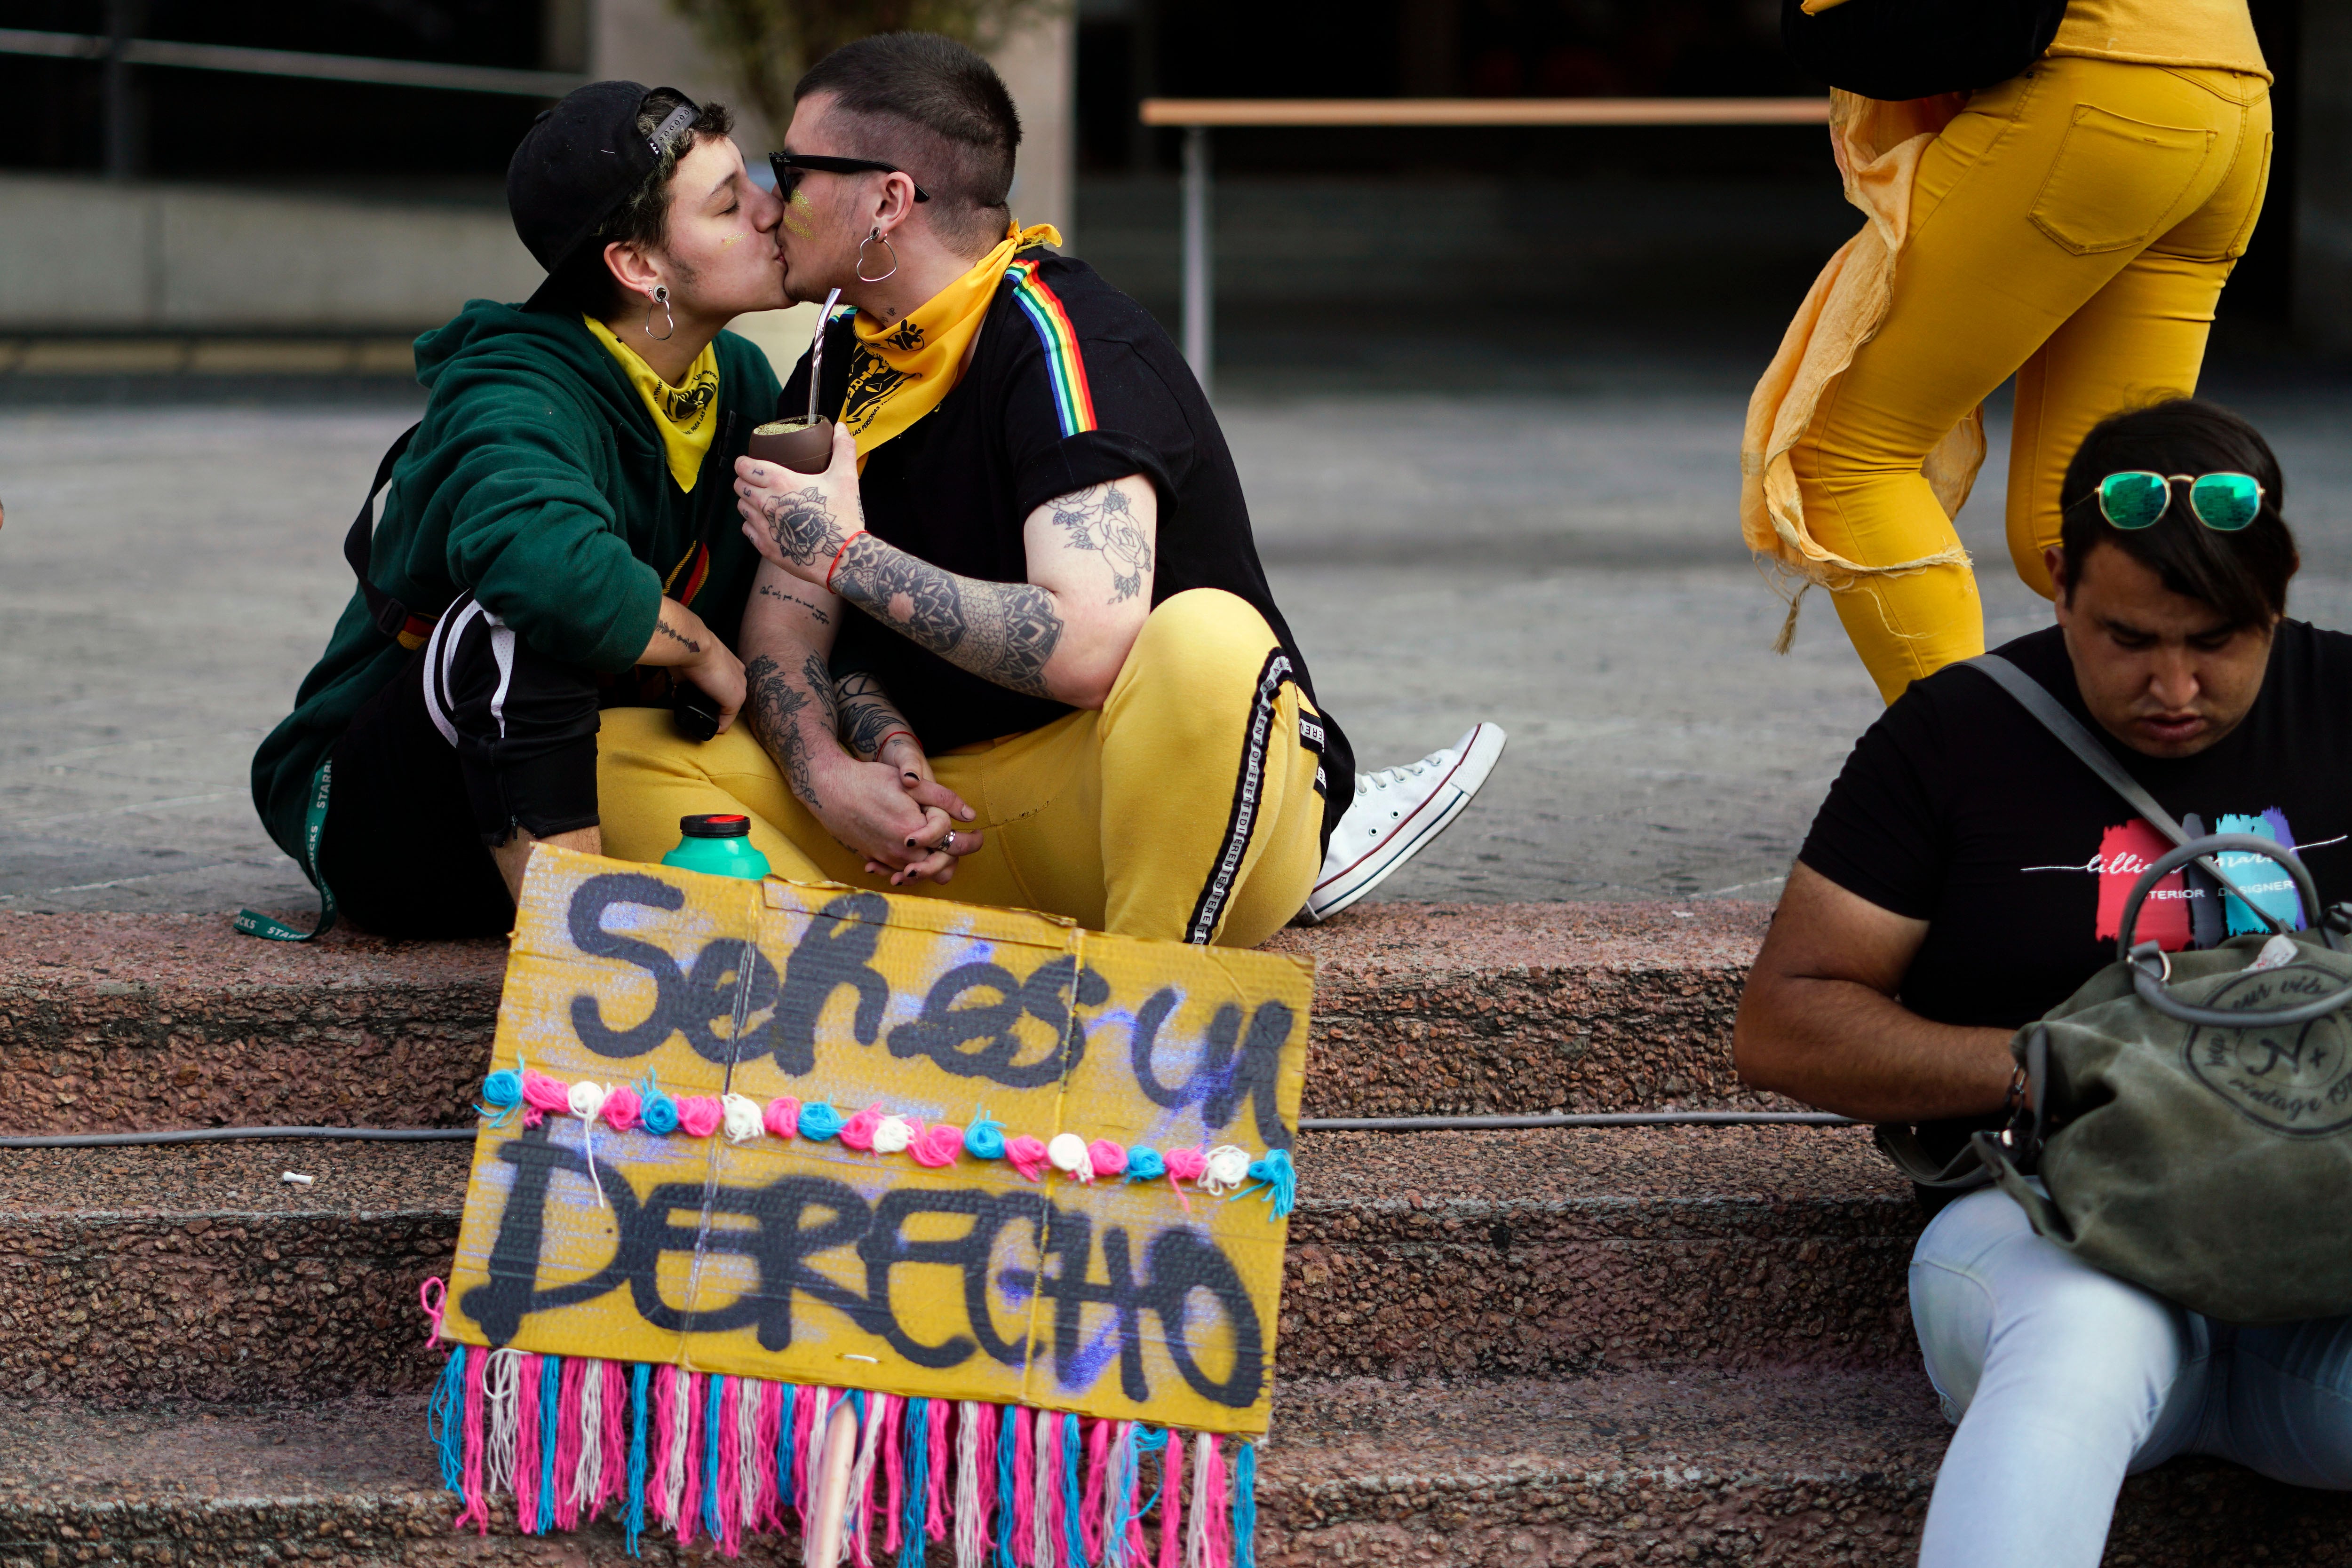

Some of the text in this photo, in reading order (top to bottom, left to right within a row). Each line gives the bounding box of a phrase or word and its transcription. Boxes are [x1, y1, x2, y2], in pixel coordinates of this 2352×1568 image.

[691, 421, 701, 432] PARA
[852, 428, 861, 436] LAS
[861, 406, 880, 431] PERSONAS
[1300, 720, 1322, 740] EREN
[2148, 880, 2296, 899] TERIOR DSIGNER
[887, 955, 1110, 1088] es
[1132, 987, 1294, 1150] un
[2228, 1079, 2322, 1121] vintage
[460, 1117, 1263, 1408] DERECHO
